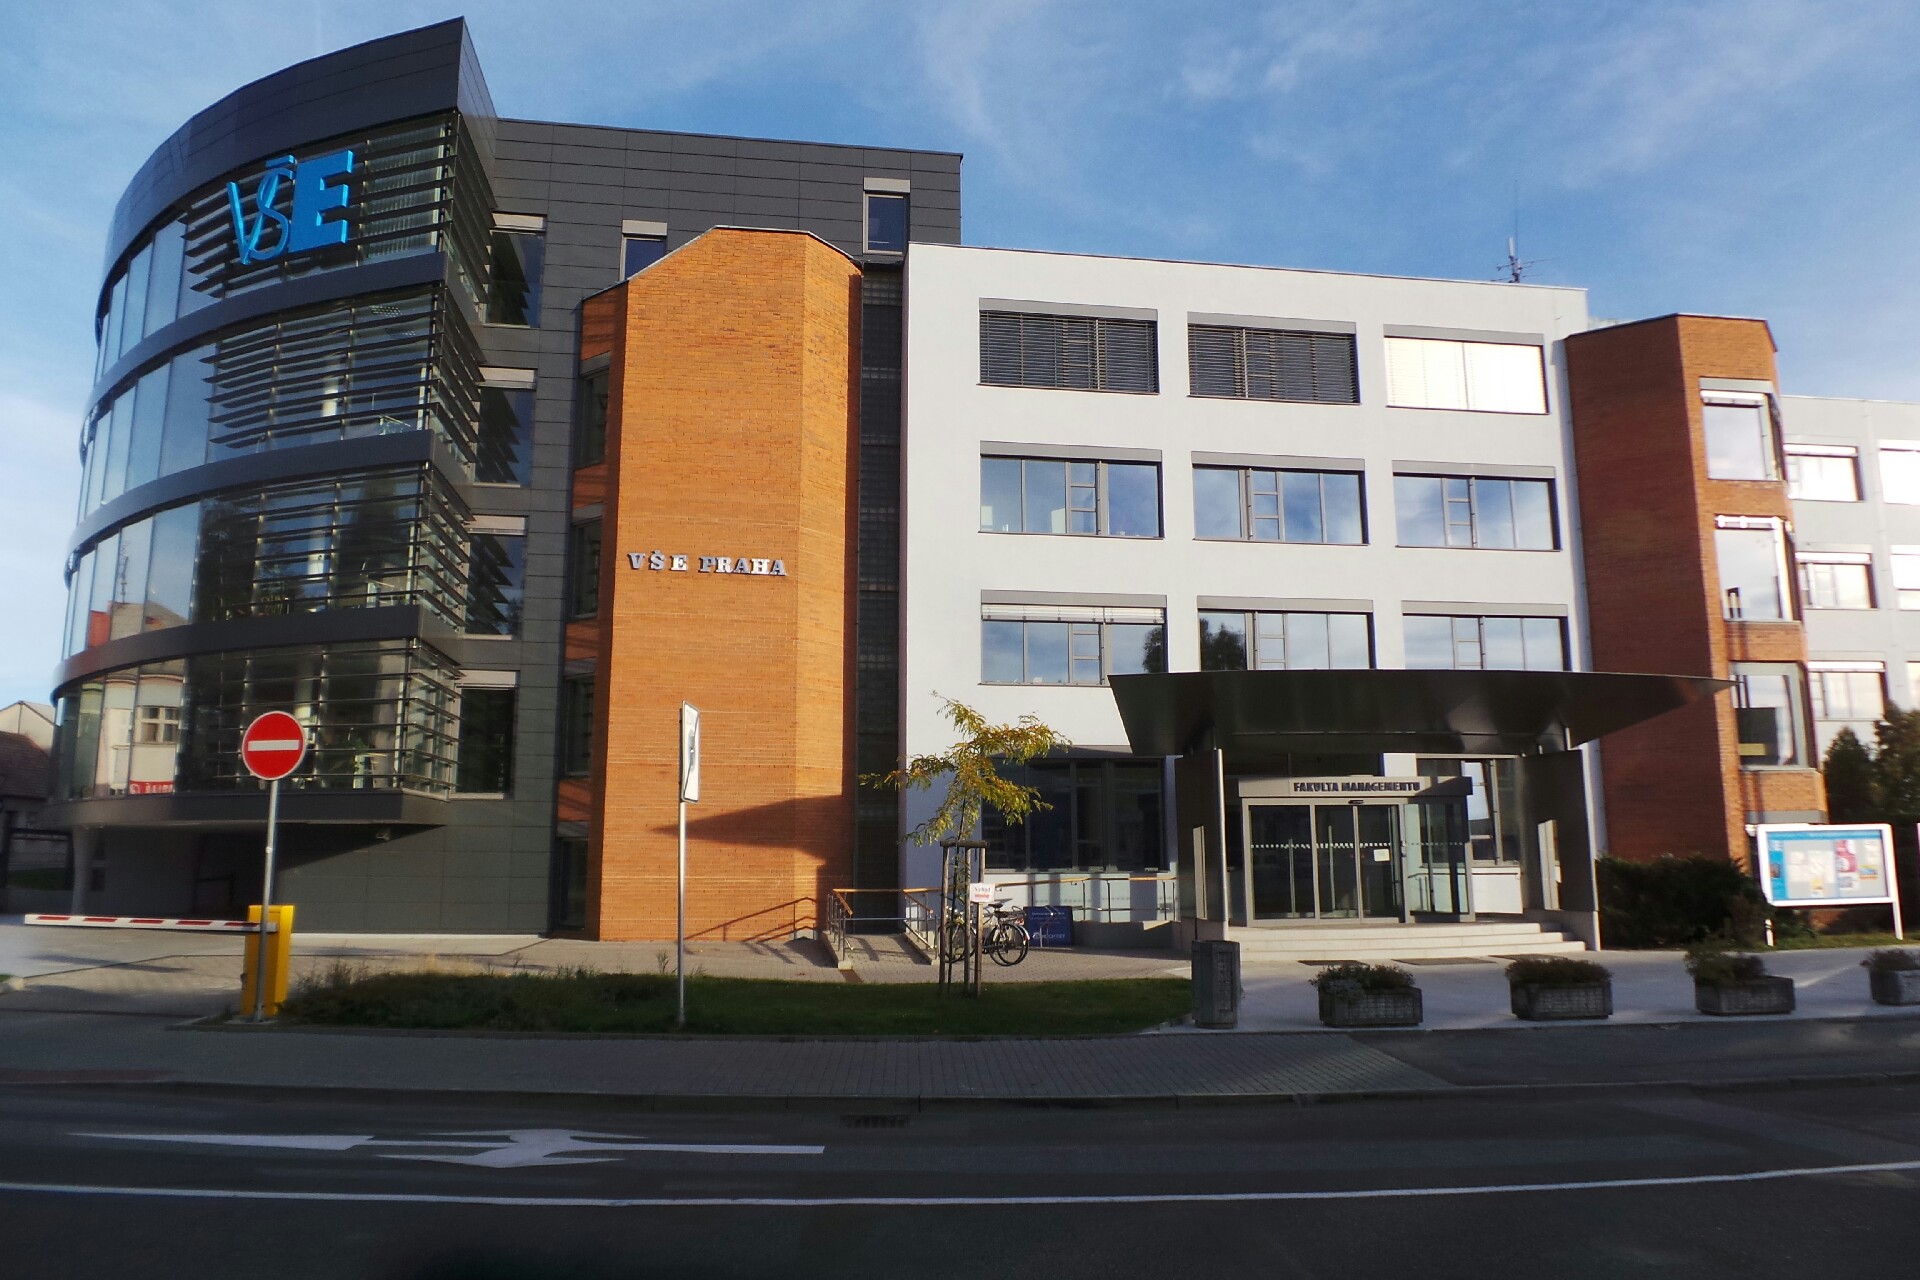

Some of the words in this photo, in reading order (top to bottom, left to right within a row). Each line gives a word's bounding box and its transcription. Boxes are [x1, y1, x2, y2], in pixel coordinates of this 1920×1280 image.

[628, 550, 688, 571] VŠE
[698, 556, 787, 577] PRAHA
[1293, 782, 1339, 792] FAKULTA
[1341, 782, 1421, 792] MANAGEMENTU
